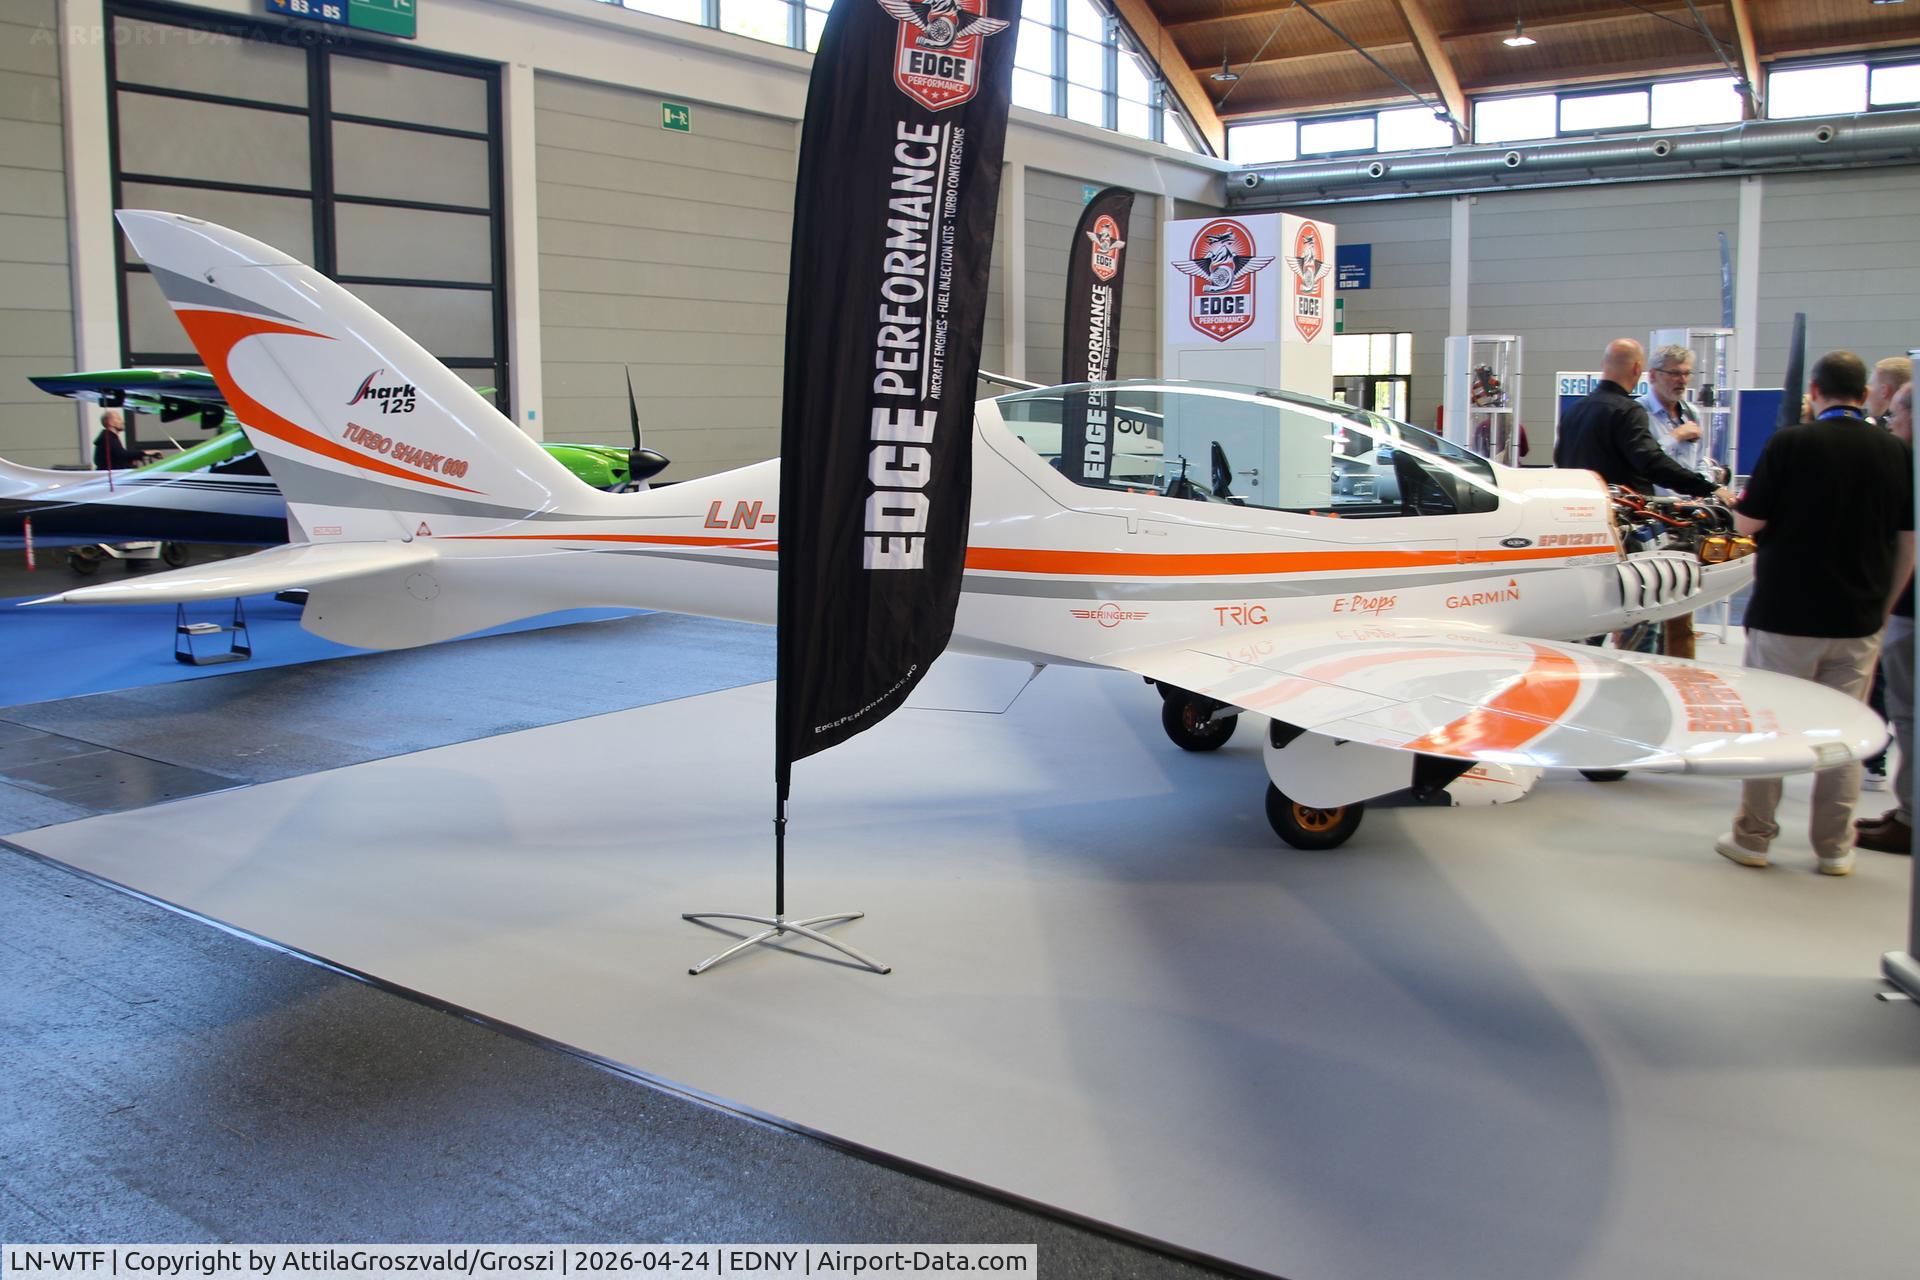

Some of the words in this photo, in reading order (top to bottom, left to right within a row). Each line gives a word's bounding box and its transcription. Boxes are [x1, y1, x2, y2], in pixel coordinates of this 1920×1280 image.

[322, 4, 341, 19] B5
[909, 50, 966, 82] EDGE
[907, 75, 965, 93] PERFORMANCE
[947, 126, 965, 188] CONVERSIONS
[944, 189, 958, 219] TURBO
[942, 225, 955, 245] KITS
[873, 120, 940, 396] PERFORMANCE
[939, 245, 954, 291] INJECTION
[1096, 254, 1112, 268] EDGE
[937, 292, 950, 313] FUEL
[1200, 296, 1245, 315] EDGE
[1298, 296, 1319, 316] EDGE
[1199, 315, 1245, 325] PERFORMANCE
[934, 319, 948, 356] ENGINES
[345, 368, 416, 406] Shark
[930, 356, 944, 400] AIRCRAFT
[380, 398, 416, 414] 125
[342, 421, 393, 454] TURBO
[391, 441, 446, 473] SHARK
[1083, 408, 1107, 479] EDGE
[863, 407, 938, 570] EDGE
[1333, 594, 1397, 616] E-Props
[1446, 588, 1520, 609] GARMIN
[1070, 608, 1134, 621] BERINGER
